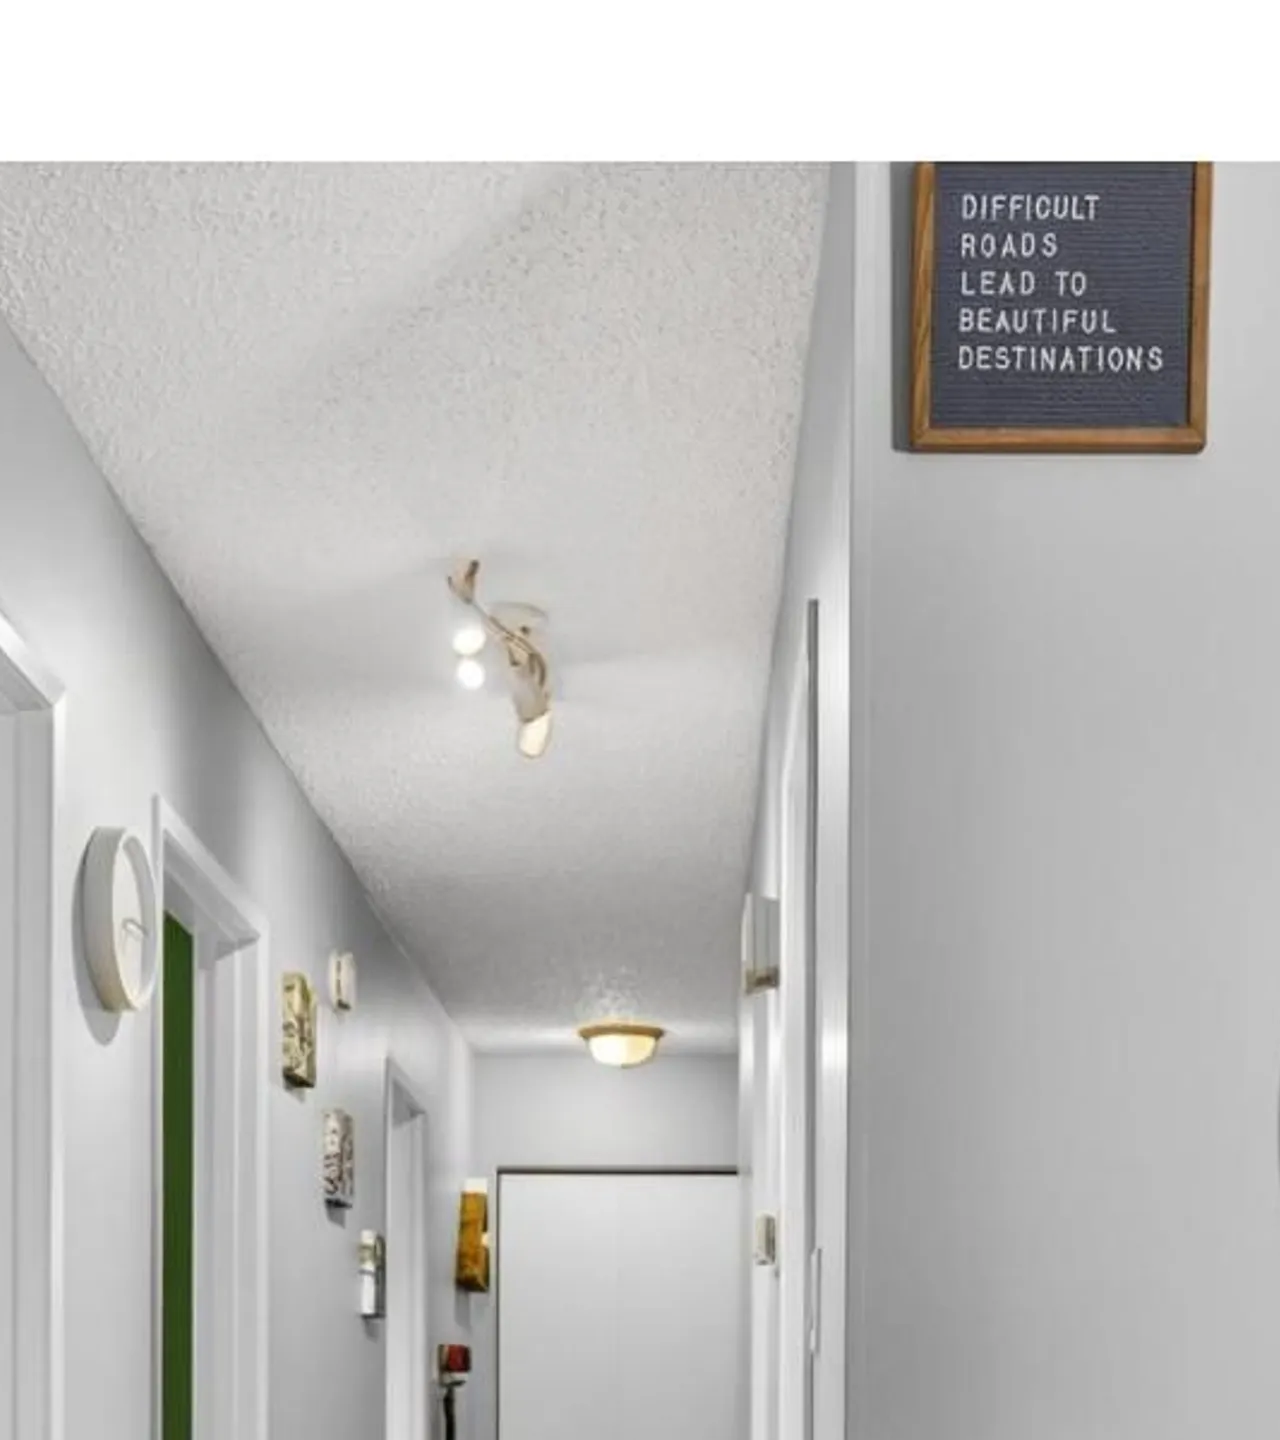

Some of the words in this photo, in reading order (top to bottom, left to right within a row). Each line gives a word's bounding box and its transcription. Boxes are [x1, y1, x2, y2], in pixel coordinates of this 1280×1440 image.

[961, 194, 1100, 221] DIFFICULT
[960, 232, 1058, 258] ROADS
[960, 270, 1036, 296] LEAD
[1054, 270, 1087, 296] TO
[958, 308, 1117, 334] BEAUTIFUL
[957, 345, 1164, 372] DESTINATIONS
